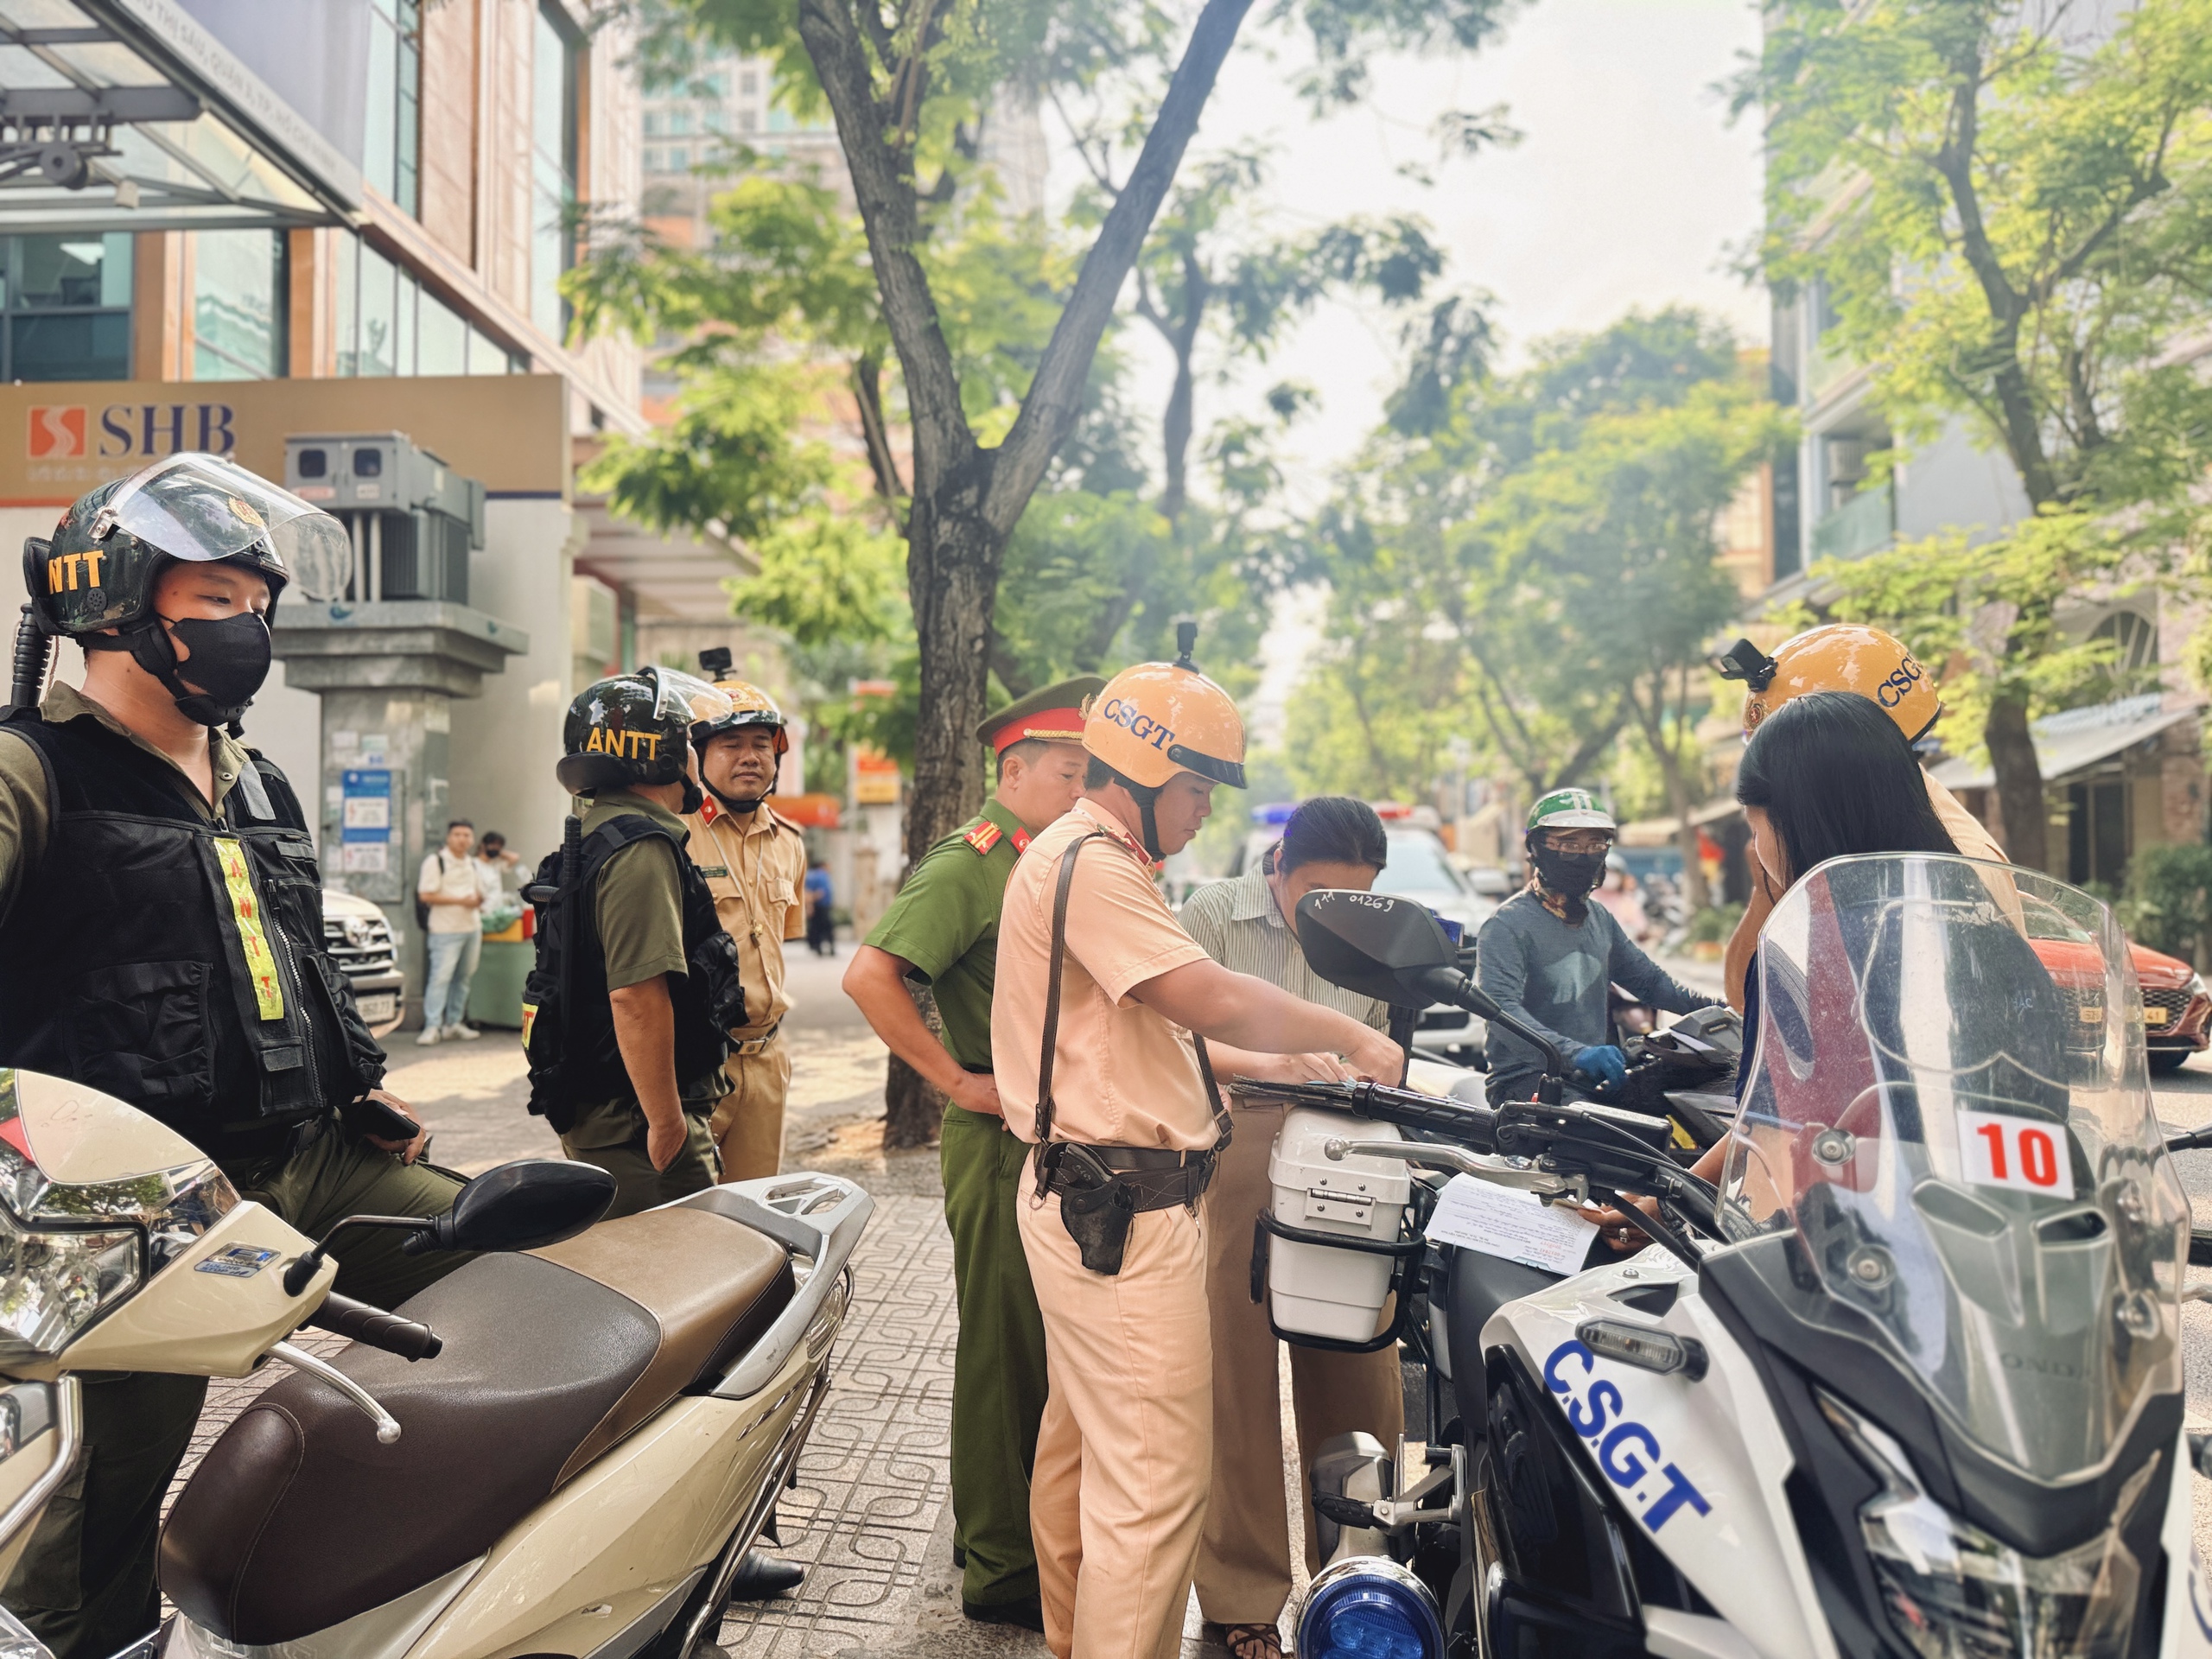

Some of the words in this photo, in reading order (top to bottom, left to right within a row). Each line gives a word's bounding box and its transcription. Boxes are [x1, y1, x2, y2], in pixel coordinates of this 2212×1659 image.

[99, 404, 235, 457] SHB
[48, 550, 105, 595] NTT
[1877, 652, 1924, 709] CSG
[586, 727, 662, 760] ANTT
[1103, 698, 1176, 751] CSGT
[1349, 893, 1395, 912] 01269
[1976, 1122, 2058, 1187] 10
[1543, 1338, 1713, 1535] C.S.G.T
